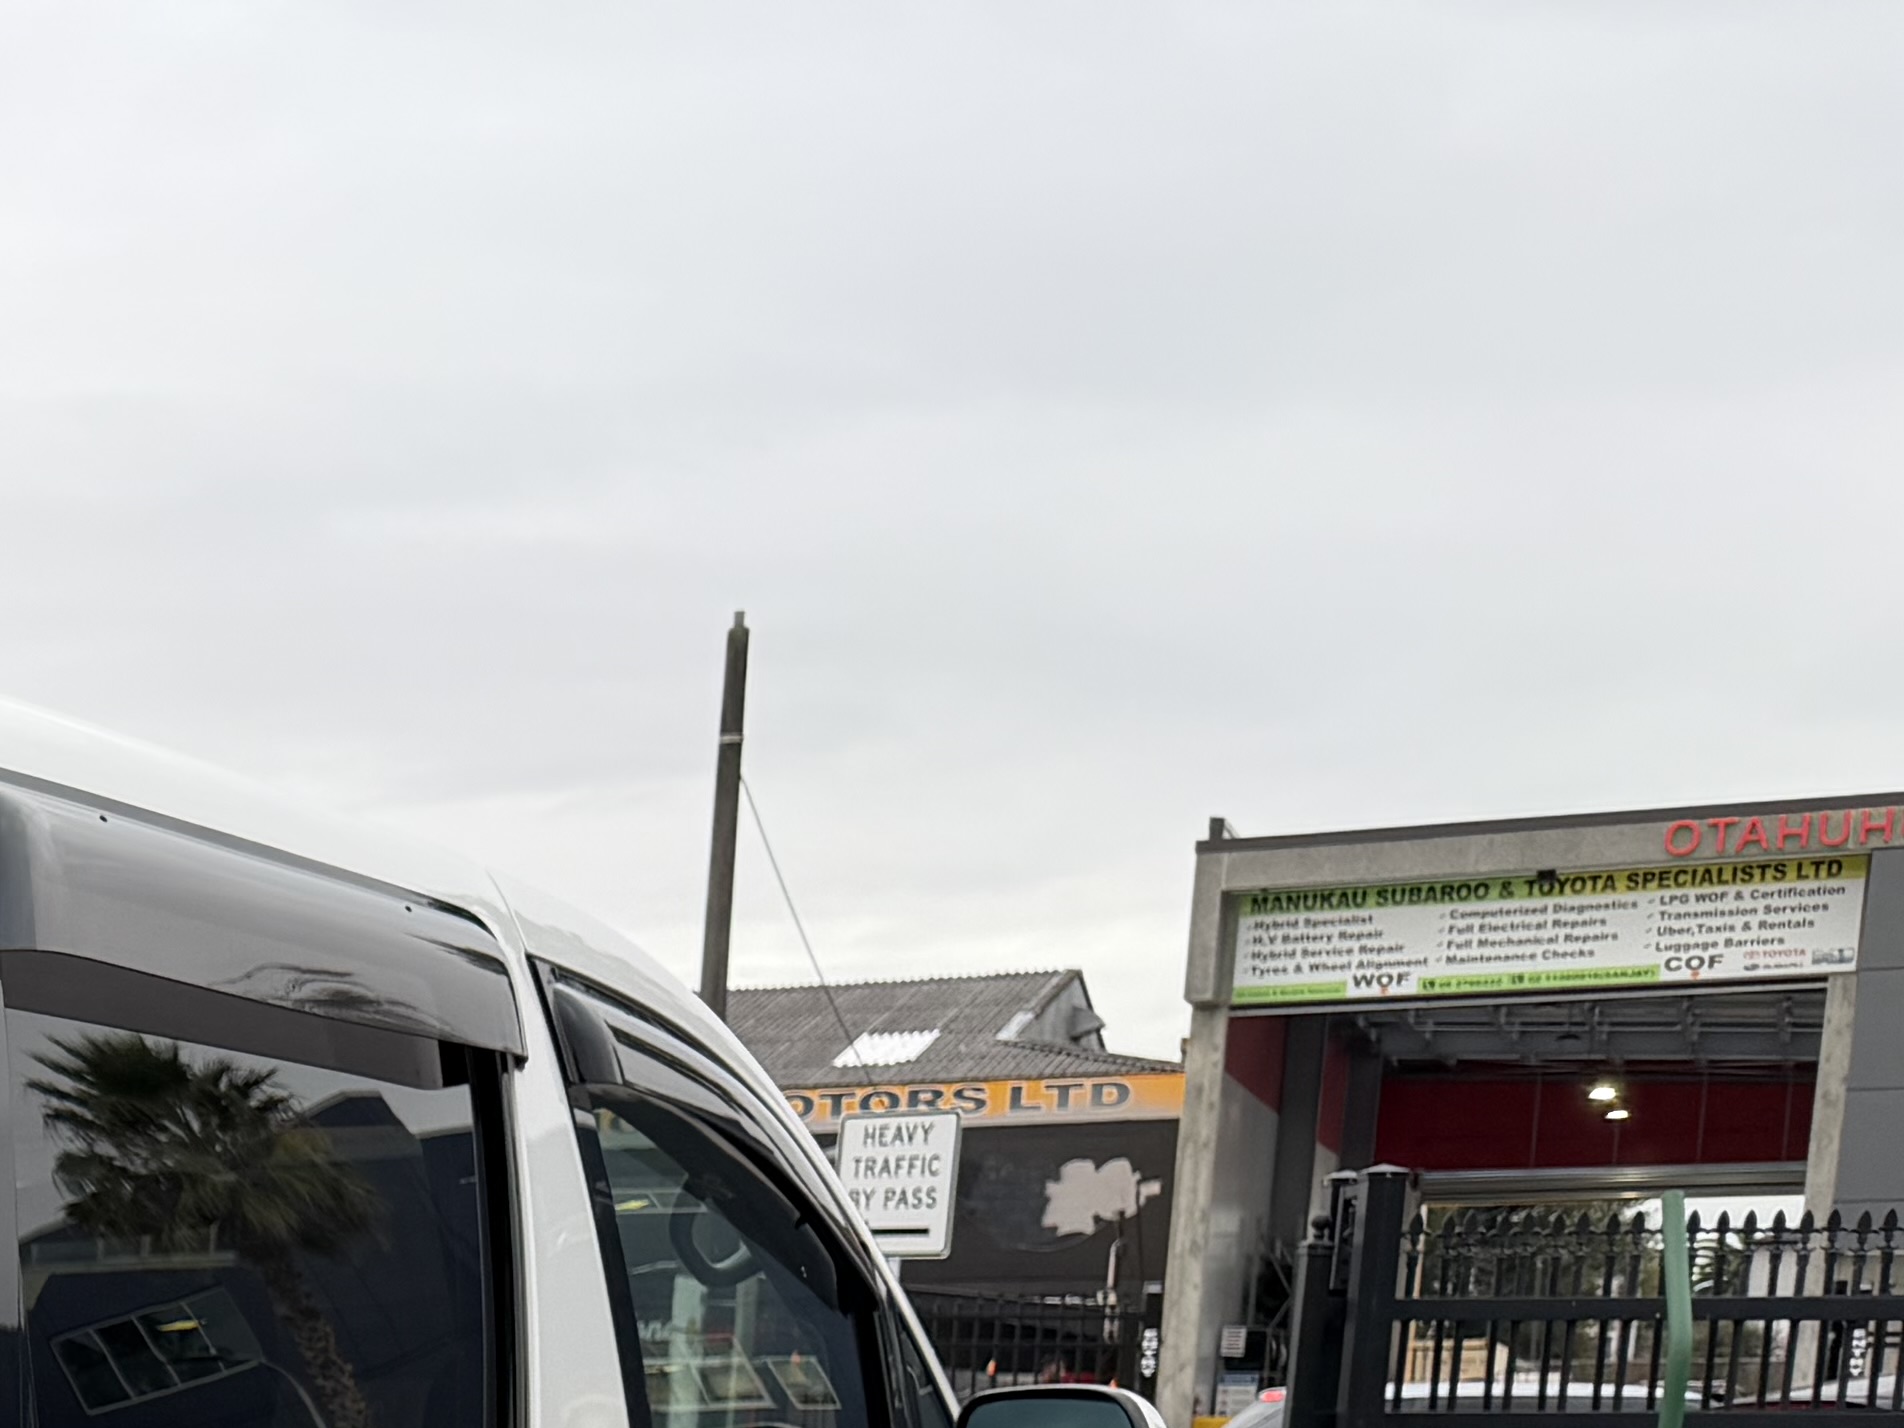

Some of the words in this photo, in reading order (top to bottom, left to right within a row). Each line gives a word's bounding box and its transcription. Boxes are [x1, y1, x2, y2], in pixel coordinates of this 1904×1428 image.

[1663, 805, 1904, 857] OTAHUH
[1250, 890, 1368, 914] MANUKAU
[1375, 882, 1490, 906] SUBAROO
[1498, 880, 1515, 900] &
[1523, 874, 1617, 898] TOYOTA
[1625, 863, 1788, 891] SPECIALISTS
[1795, 858, 1843, 881] LTD
[1659, 893, 1690, 906] LPG
[1694, 891, 1729, 904] WOF
[1733, 889, 1745, 902] &
[1750, 884, 1847, 901] Certification
[1449, 903, 1548, 921] Computerized
[1552, 899, 1639, 917] Diagnostics
[1658, 906, 1759, 921] Transmission
[1763, 902, 1830, 916] Services
[1253, 918, 1300, 932] Hybrid
[1304, 914, 1374, 929] Specialist
[1447, 923, 1475, 936] Full
[1478, 919, 1548, 934] Electrical
[1552, 916, 1607, 931] Repairs
[1741, 920, 1753, 932] &
[1757, 917, 1815, 931] Rentals
[1281, 931, 1334, 945] Battery
[1338, 929, 1384, 943] Repair
[1445, 938, 1473, 951] Full
[1476, 933, 1559, 949] Mechanical
[1563, 930, 1619, 946] Repairs
[1654, 938, 1719, 955] Luggage
[1723, 935, 1786, 950] Barriers
[1250, 949, 1297, 963] Hybrid
[1300, 947, 1354, 960] Service
[1358, 943, 1405, 957] Repair
[1444, 952, 1537, 966] Maintenance
[1541, 948, 1596, 962] Checks
[1251, 965, 1288, 979] Tyres
[1309, 959, 1352, 973] Wheel
[1355, 956, 1429, 972] Alignment
[1663, 954, 1725, 973] COF
[1352, 971, 1411, 989] WOF
[1006, 1079, 1132, 1112] LTD
[862, 1121, 935, 1149] HEAVY
[852, 1153, 941, 1180] TRAFFIC
[883, 1185, 938, 1211] PASS
